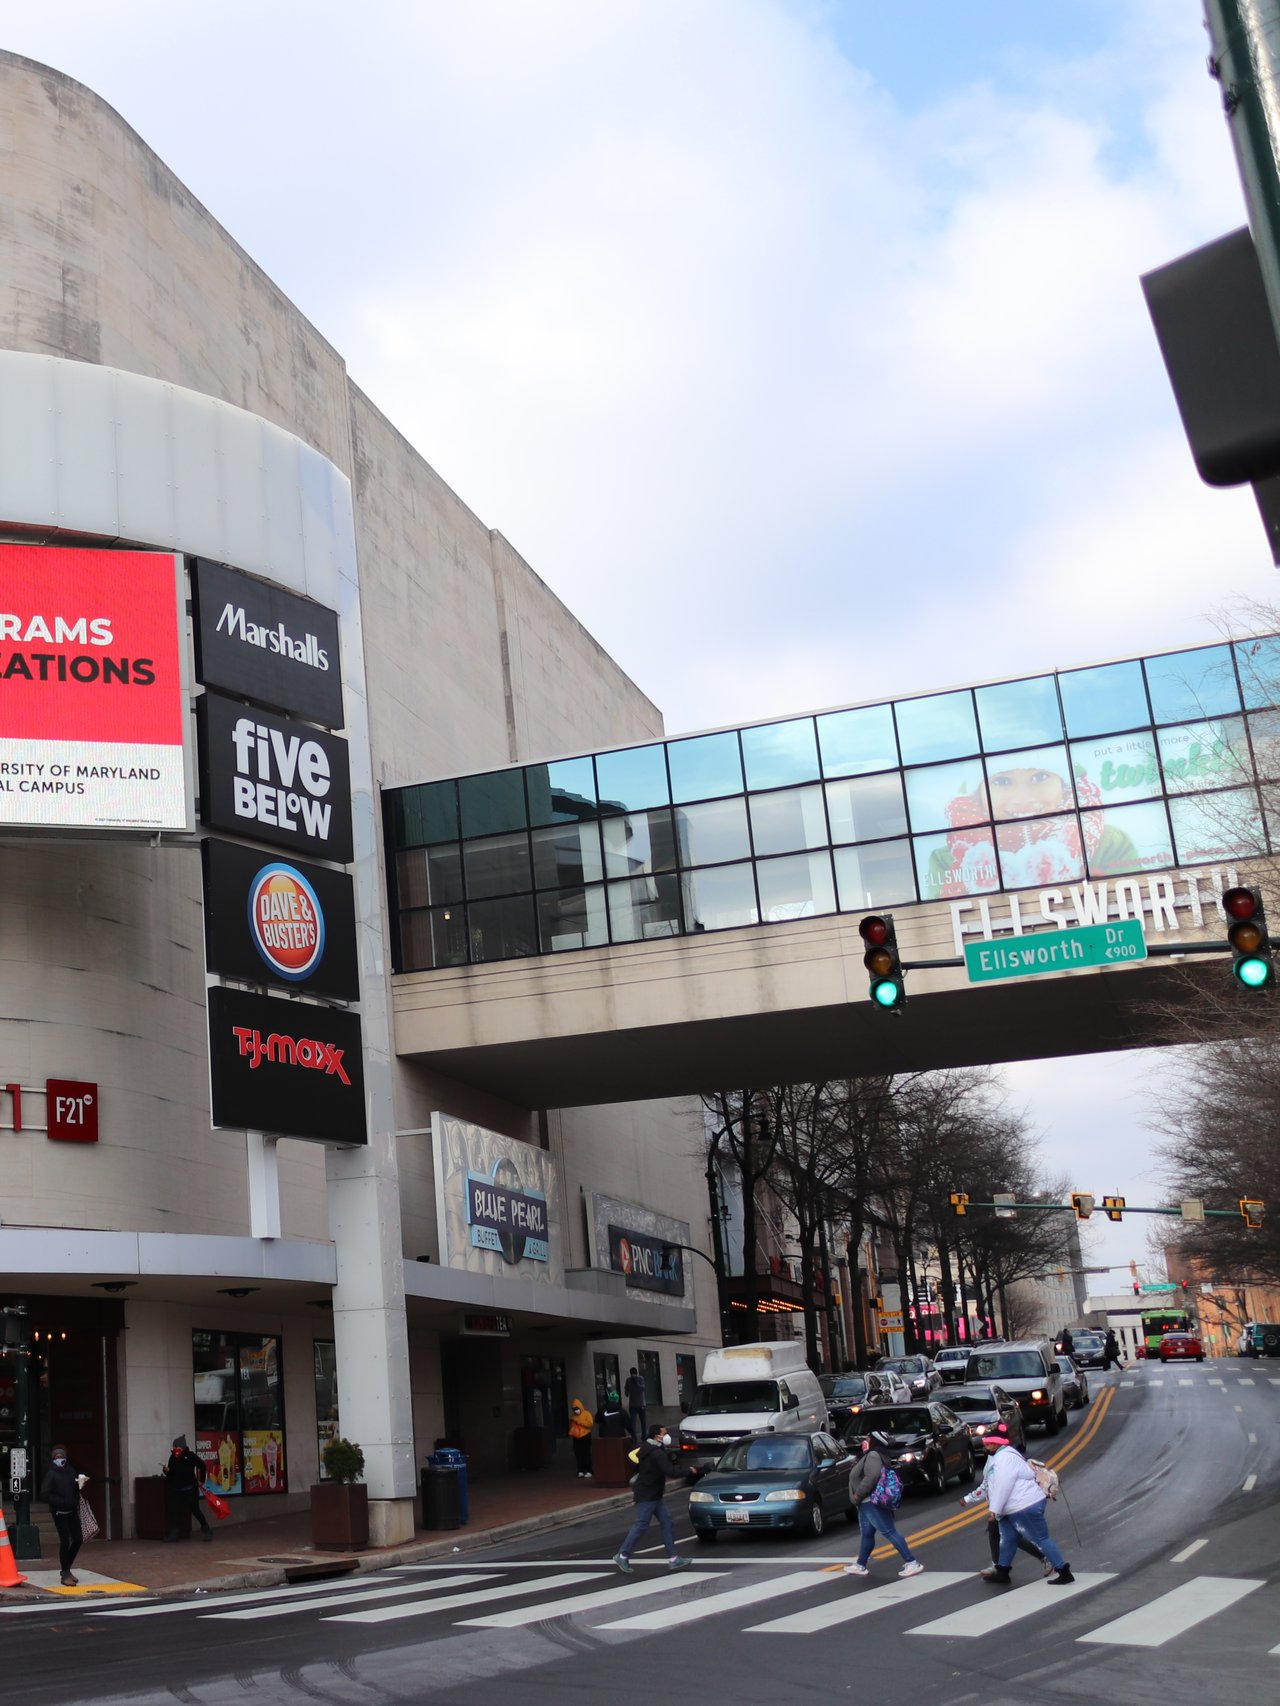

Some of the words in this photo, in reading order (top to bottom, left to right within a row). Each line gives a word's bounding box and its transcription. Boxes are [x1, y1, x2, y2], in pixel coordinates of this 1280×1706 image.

[216, 603, 329, 671] Marshalls
[232, 718, 330, 797] five
[1094, 745, 1113, 757] put
[1126, 740, 1152, 751] little
[1160, 734, 1189, 745] more
[50, 764, 70, 776] OF
[76, 766, 160, 780] MARYLAND
[19, 780, 85, 794] CAMPUS
[261, 892, 300, 921] DAVE
[299, 895, 313, 921] &
[263, 922, 315, 949] BUSTER'S
[979, 939, 1083, 971] Ellsworth
[1105, 928, 1124, 944] Dr
[1114, 945, 1136, 957] 900
[56, 1096, 84, 1124] F21
[475, 1189, 507, 1222] BLUE
[511, 1199, 545, 1232] PEARL
[477, 1229, 497, 1245] BUFFET
